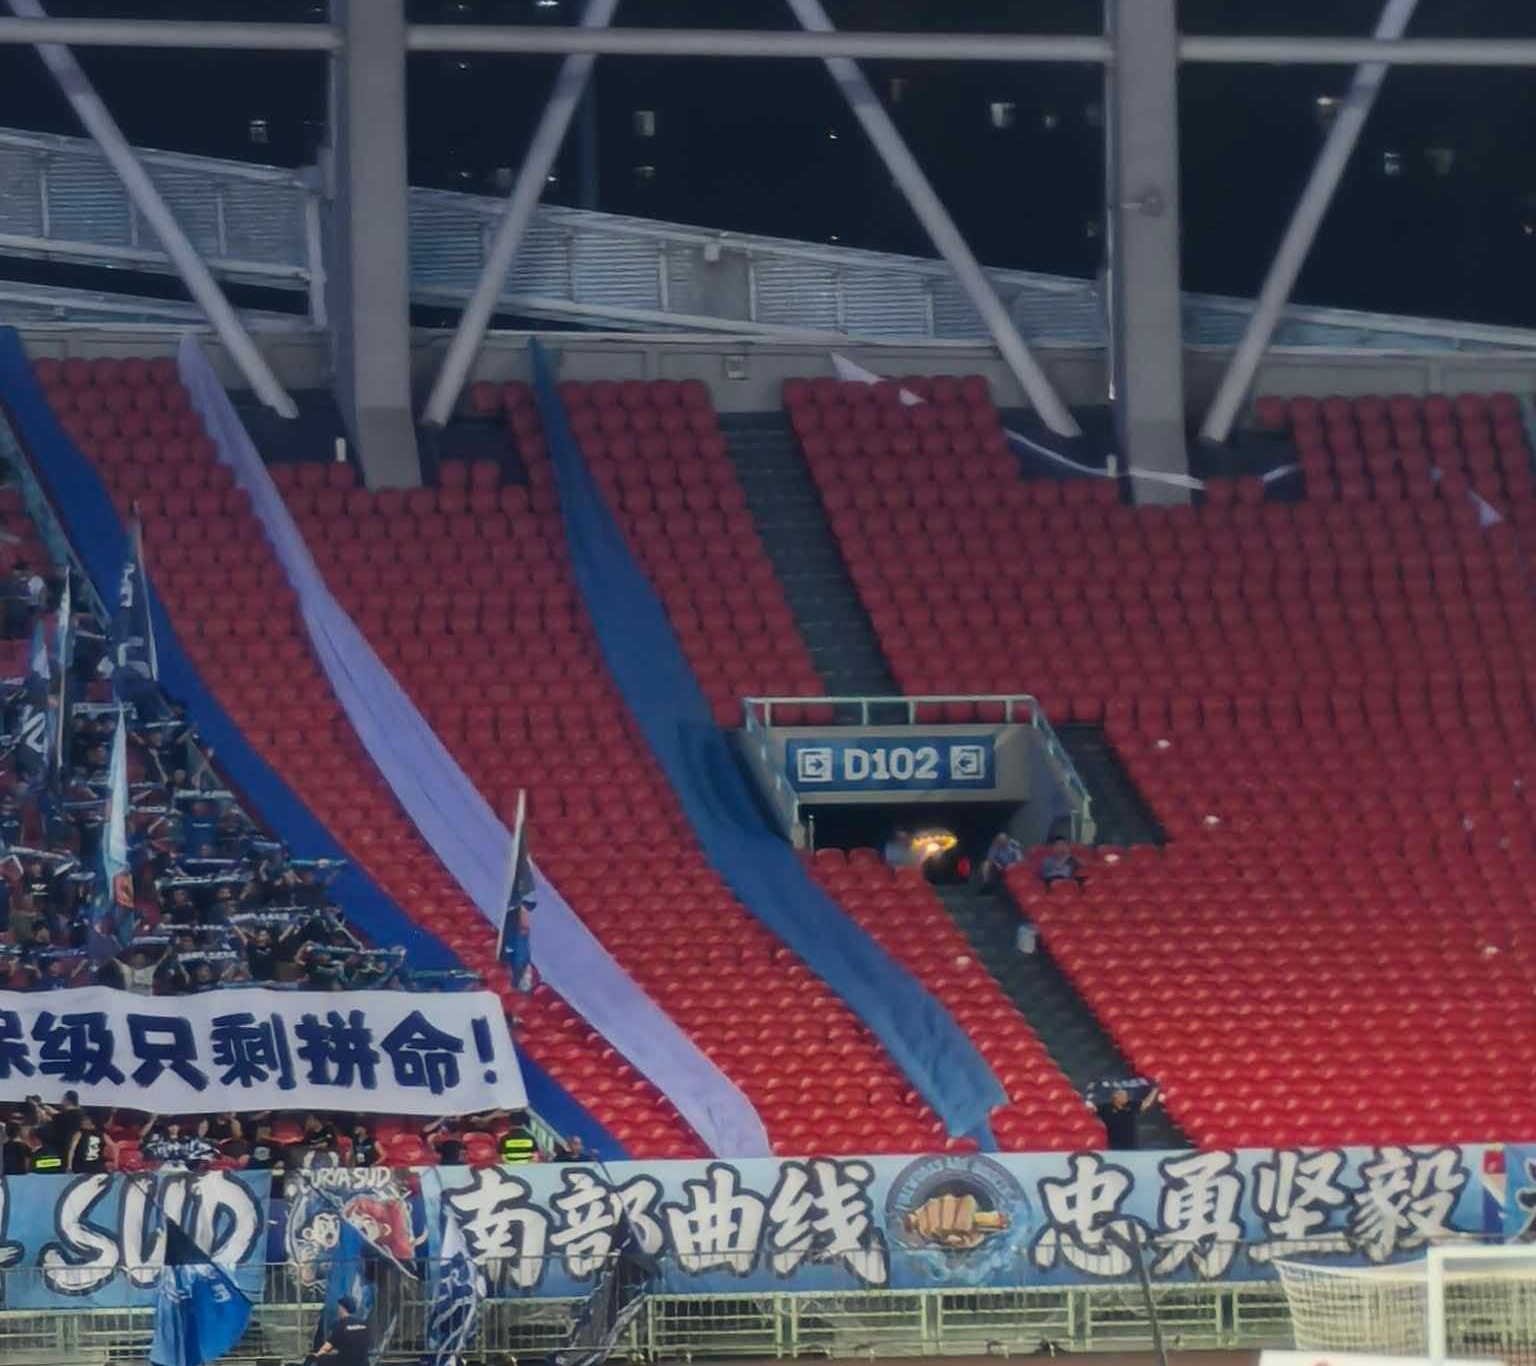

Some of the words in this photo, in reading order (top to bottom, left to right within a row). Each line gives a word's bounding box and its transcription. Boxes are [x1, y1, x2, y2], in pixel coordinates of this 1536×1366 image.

[843, 747, 939, 780] D102
[38, 1171, 260, 1295] SUD
[449, 1159, 889, 1290] 南部曲线
[1033, 1145, 1476, 1278] 忠勇坚毅
